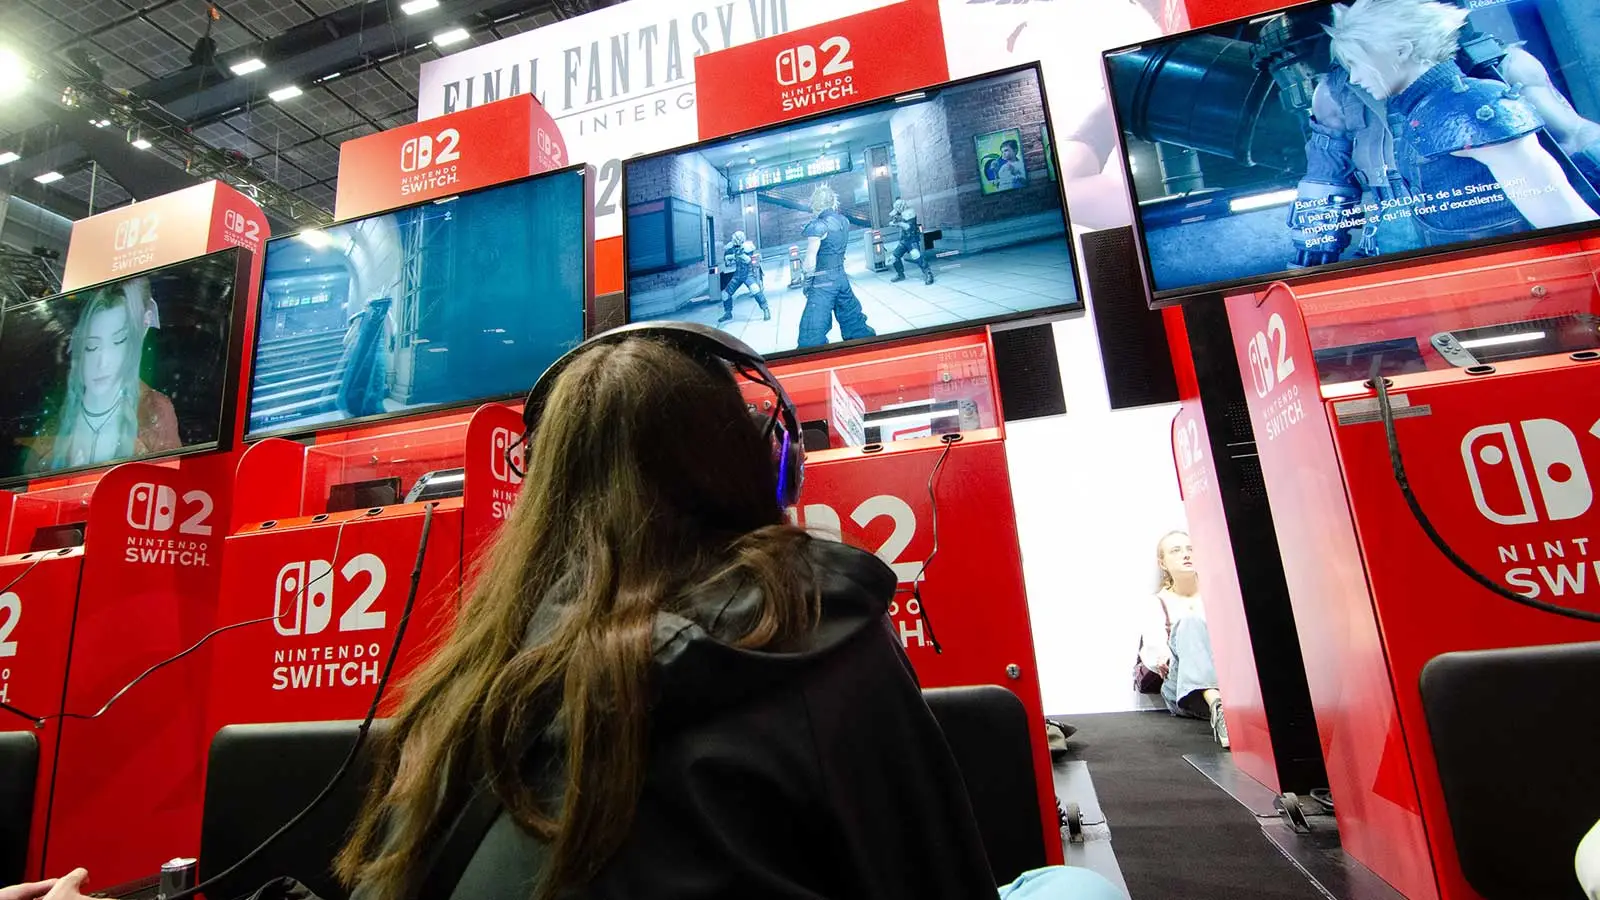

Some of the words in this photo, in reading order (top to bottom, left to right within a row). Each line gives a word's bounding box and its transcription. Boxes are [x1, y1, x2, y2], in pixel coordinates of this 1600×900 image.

[443, 58, 546, 115] FINAL
[561, 2, 736, 110] FANTASY
[819, 36, 854, 76] 2
[781, 75, 853, 99] NINTENDO
[782, 83, 856, 112] SWITCH
[435, 128, 460, 165] 2
[400, 165, 457, 185] NINTENDO
[400, 173, 458, 196] SWITCH
[1294, 197, 1329, 210] Barret
[1302, 218, 1367, 235] impitoyables
[1369, 213, 1381, 222] et
[1383, 209, 1412, 222] qu'ils
[1414, 204, 1438, 216] font
[1439, 193, 1505, 211] d'excellents
[1342, 206, 1362, 217] que
[1364, 202, 1379, 212] les
[1380, 193, 1434, 209] SOLDATs
[1435, 190, 1450, 200] de
[1452, 188, 1463, 197] la
[1464, 181, 1501, 195] Shinra
[245, 219, 260, 242] 2
[1304, 235, 1338, 248] garde.
[1267, 312, 1296, 384] 2
[1263, 384, 1299, 420] NINTENDO
[1265, 399, 1305, 441] SWITCH
[179, 489, 214, 536] 2
[127, 536, 207, 551] NINTENDO
[850, 494, 925, 581] 2
[125, 547, 208, 567] SWITCH
[339, 552, 387, 632] 2
[274, 642, 380, 664] NINTENDO
[271, 660, 380, 691] SWITCH
